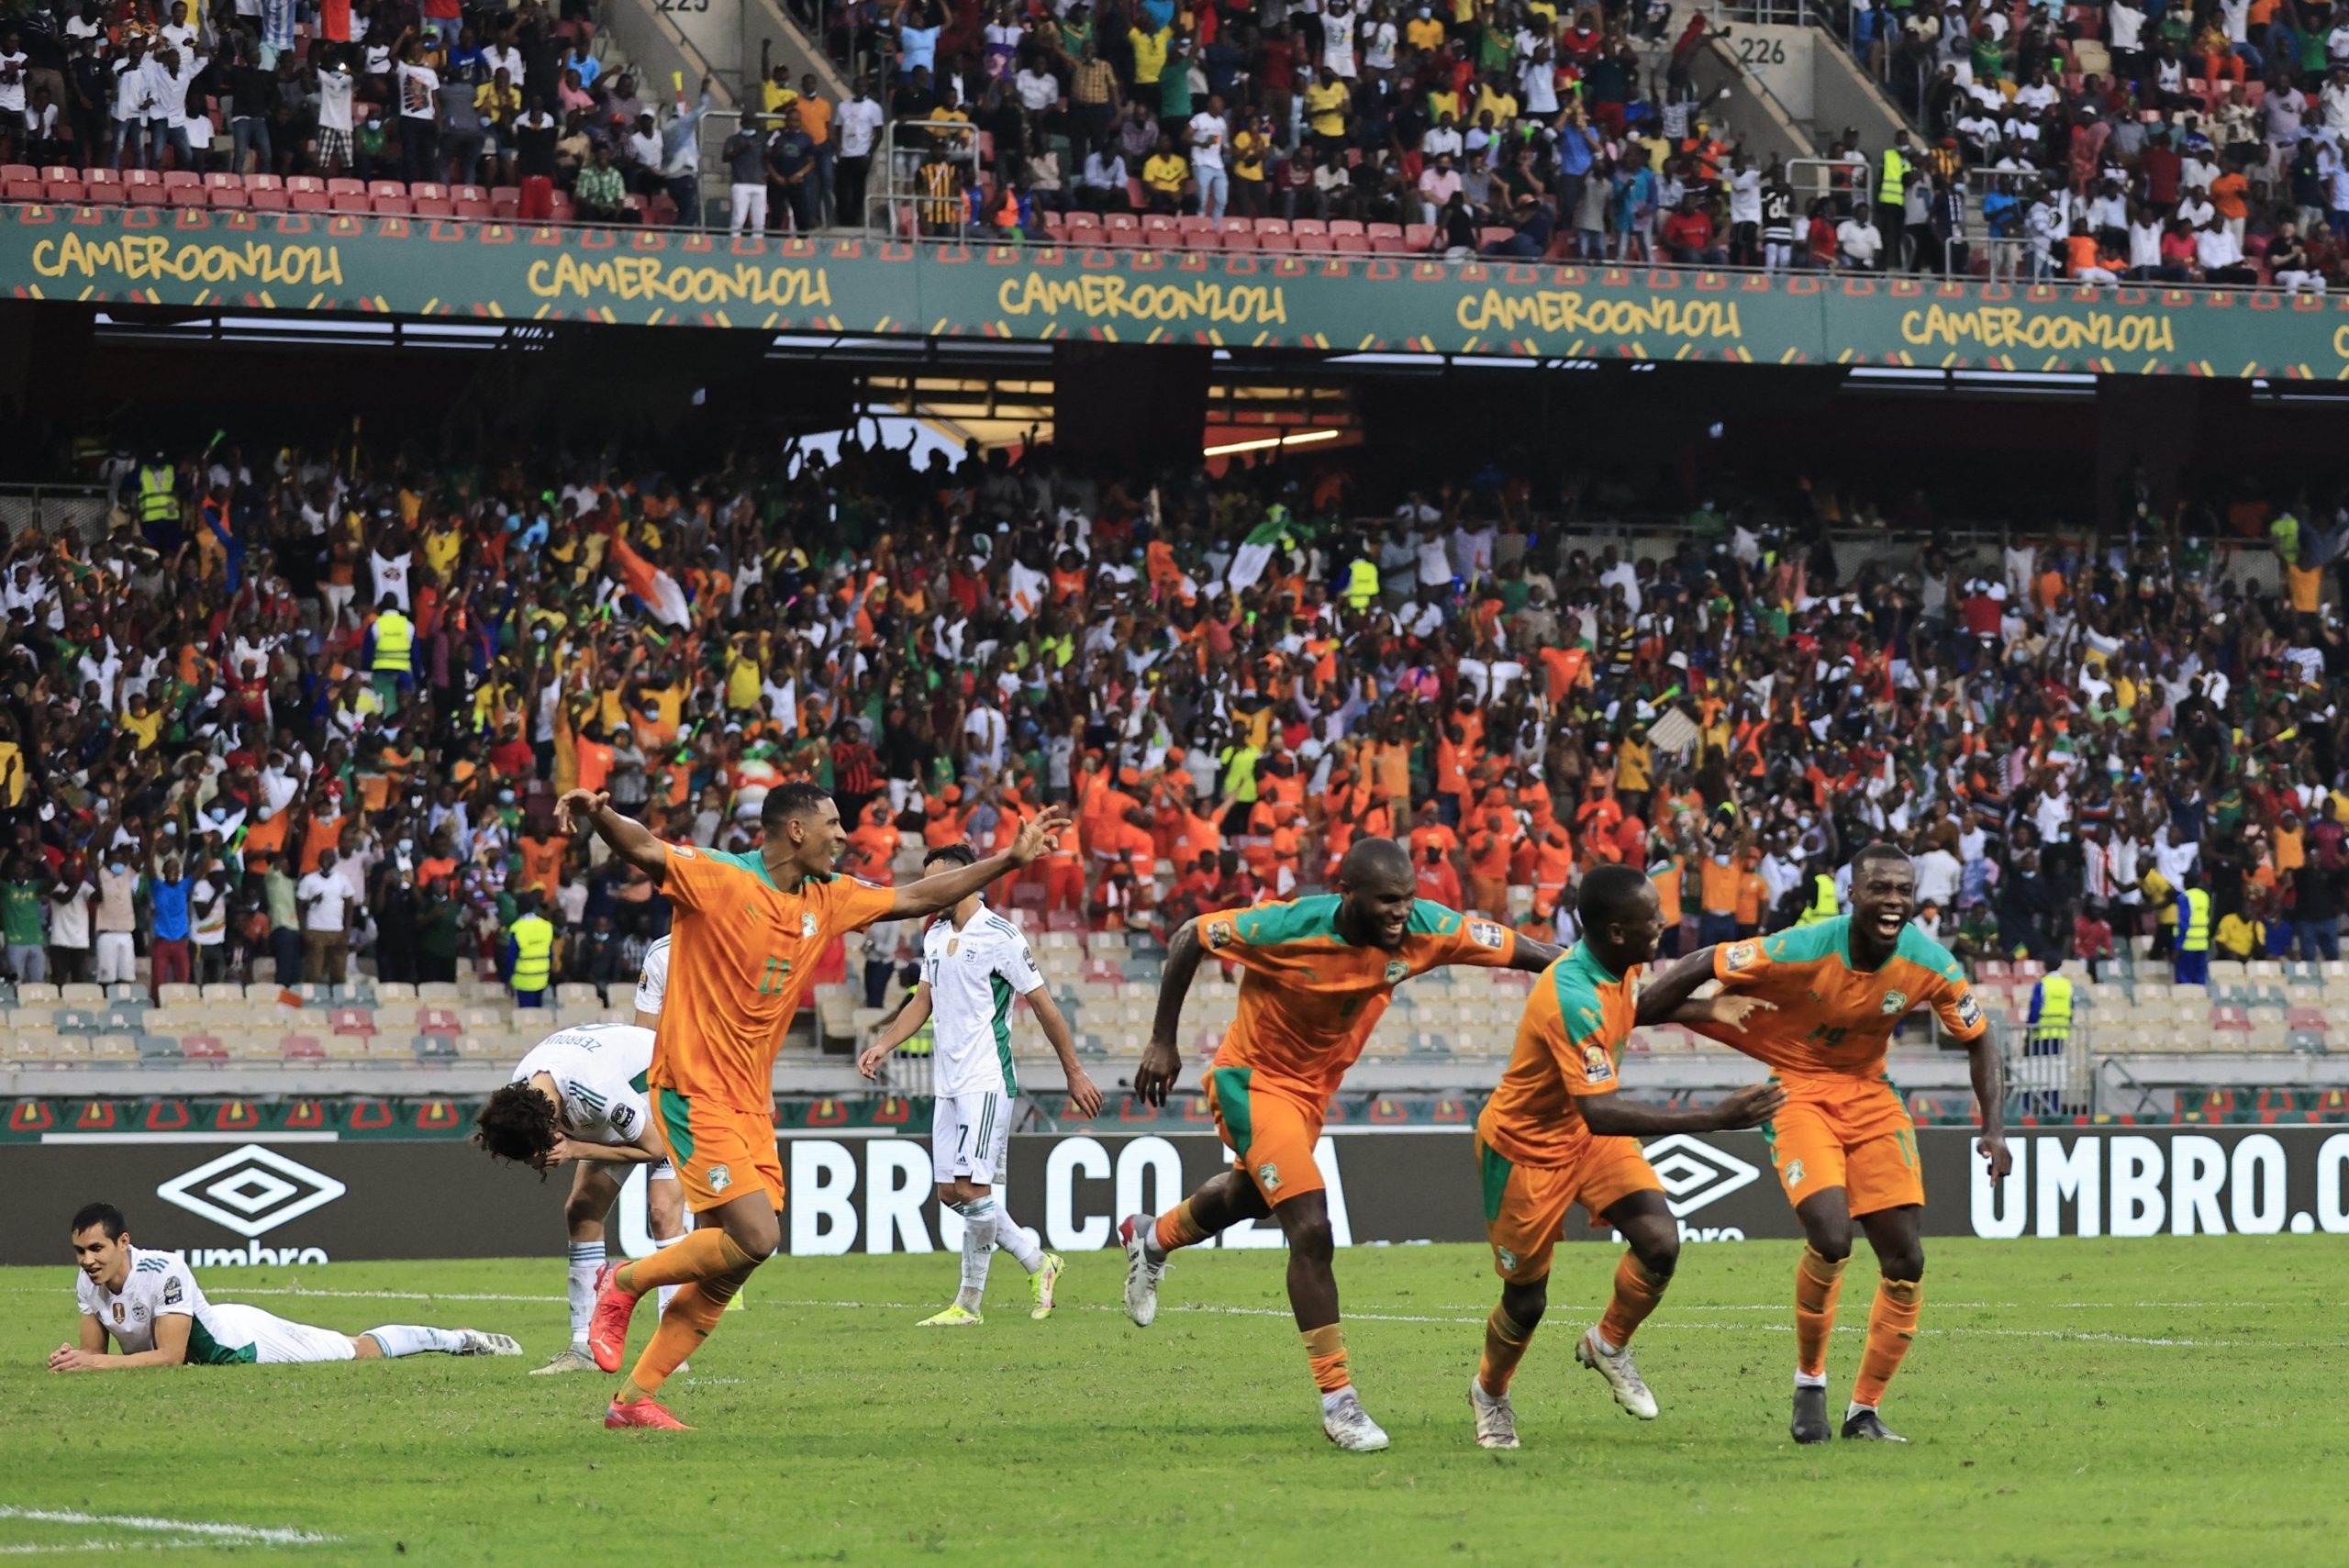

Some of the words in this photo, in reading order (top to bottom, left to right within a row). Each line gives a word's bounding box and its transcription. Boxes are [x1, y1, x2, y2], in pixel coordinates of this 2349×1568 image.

[1739, 38, 1785, 64] 226
[32, 231, 343, 285] CAMEROON2021
[528, 252, 831, 306] CAMEROON2021
[998, 272, 1286, 323] CAMEROON2021
[1457, 288, 1741, 338] CAMEROON2021
[1901, 304, 2174, 352] CAMEROON2021
